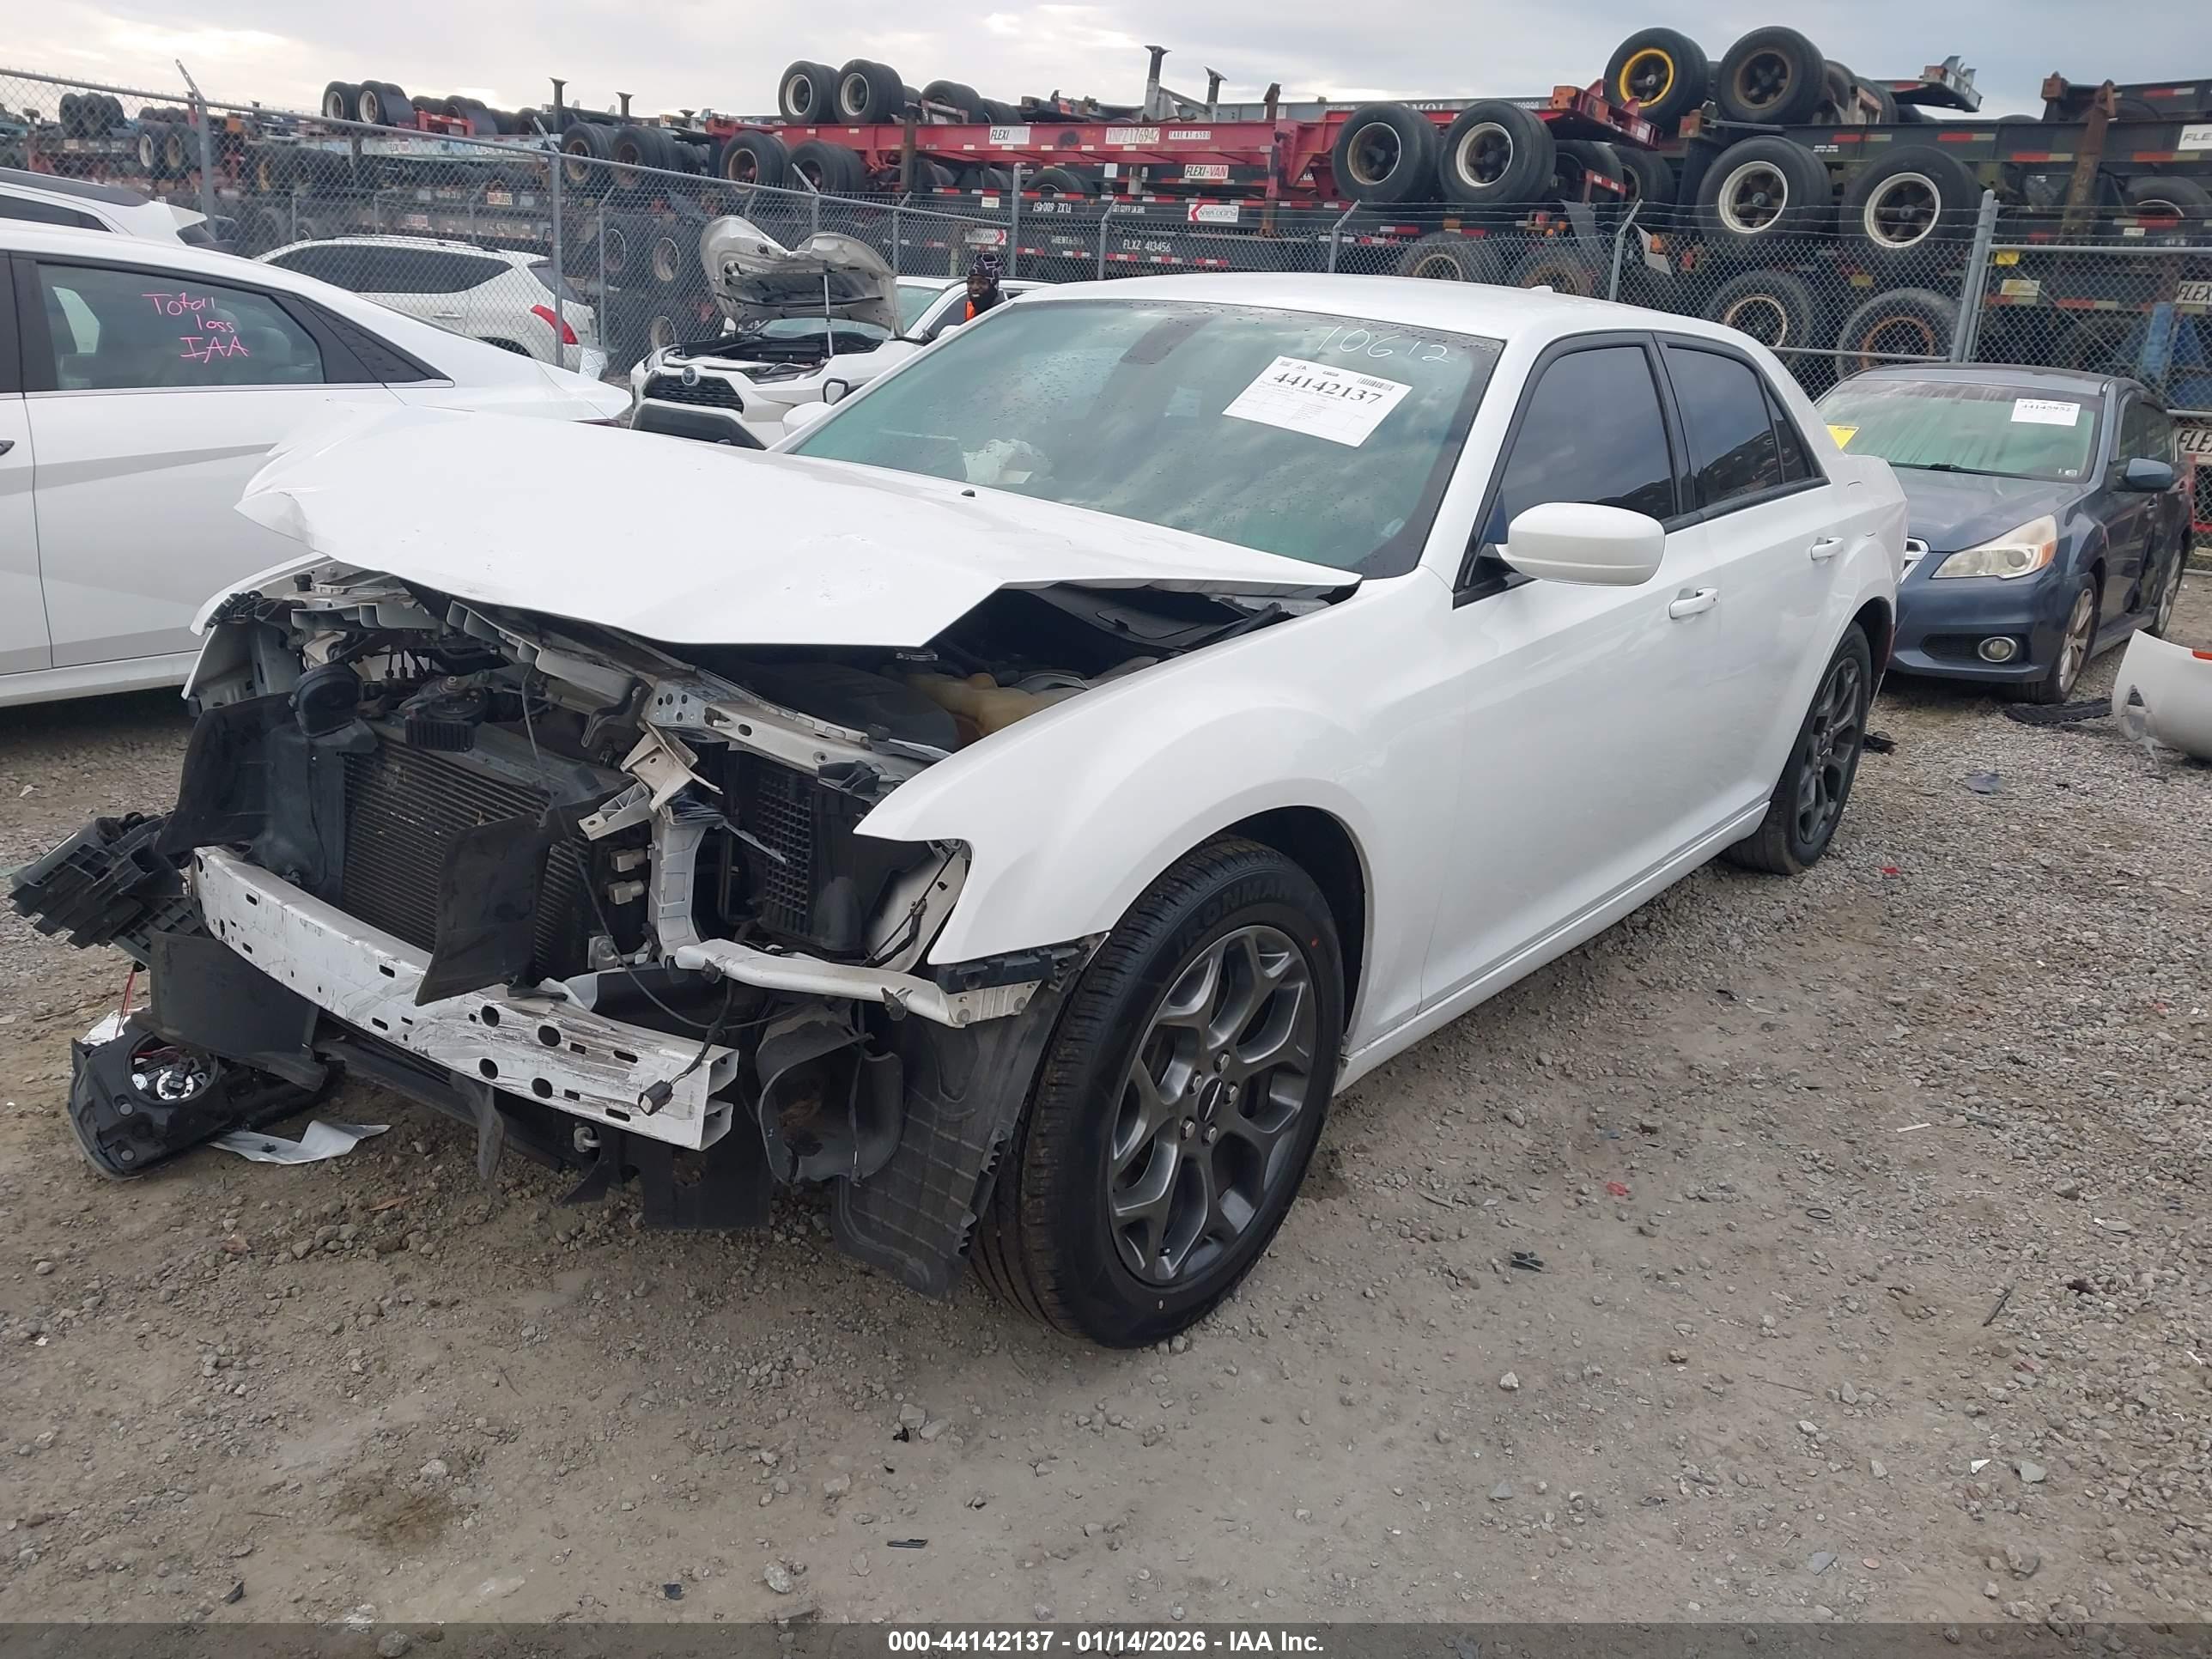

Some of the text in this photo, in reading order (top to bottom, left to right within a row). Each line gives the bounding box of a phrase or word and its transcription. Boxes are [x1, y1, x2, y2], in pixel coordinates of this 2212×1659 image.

[990, 129, 1010, 141] FLEXI
[142, 292, 216, 315] Total
[196, 314, 235, 333] loss
[179, 336, 250, 363] IAA
[1273, 372, 1383, 404] 44142137
